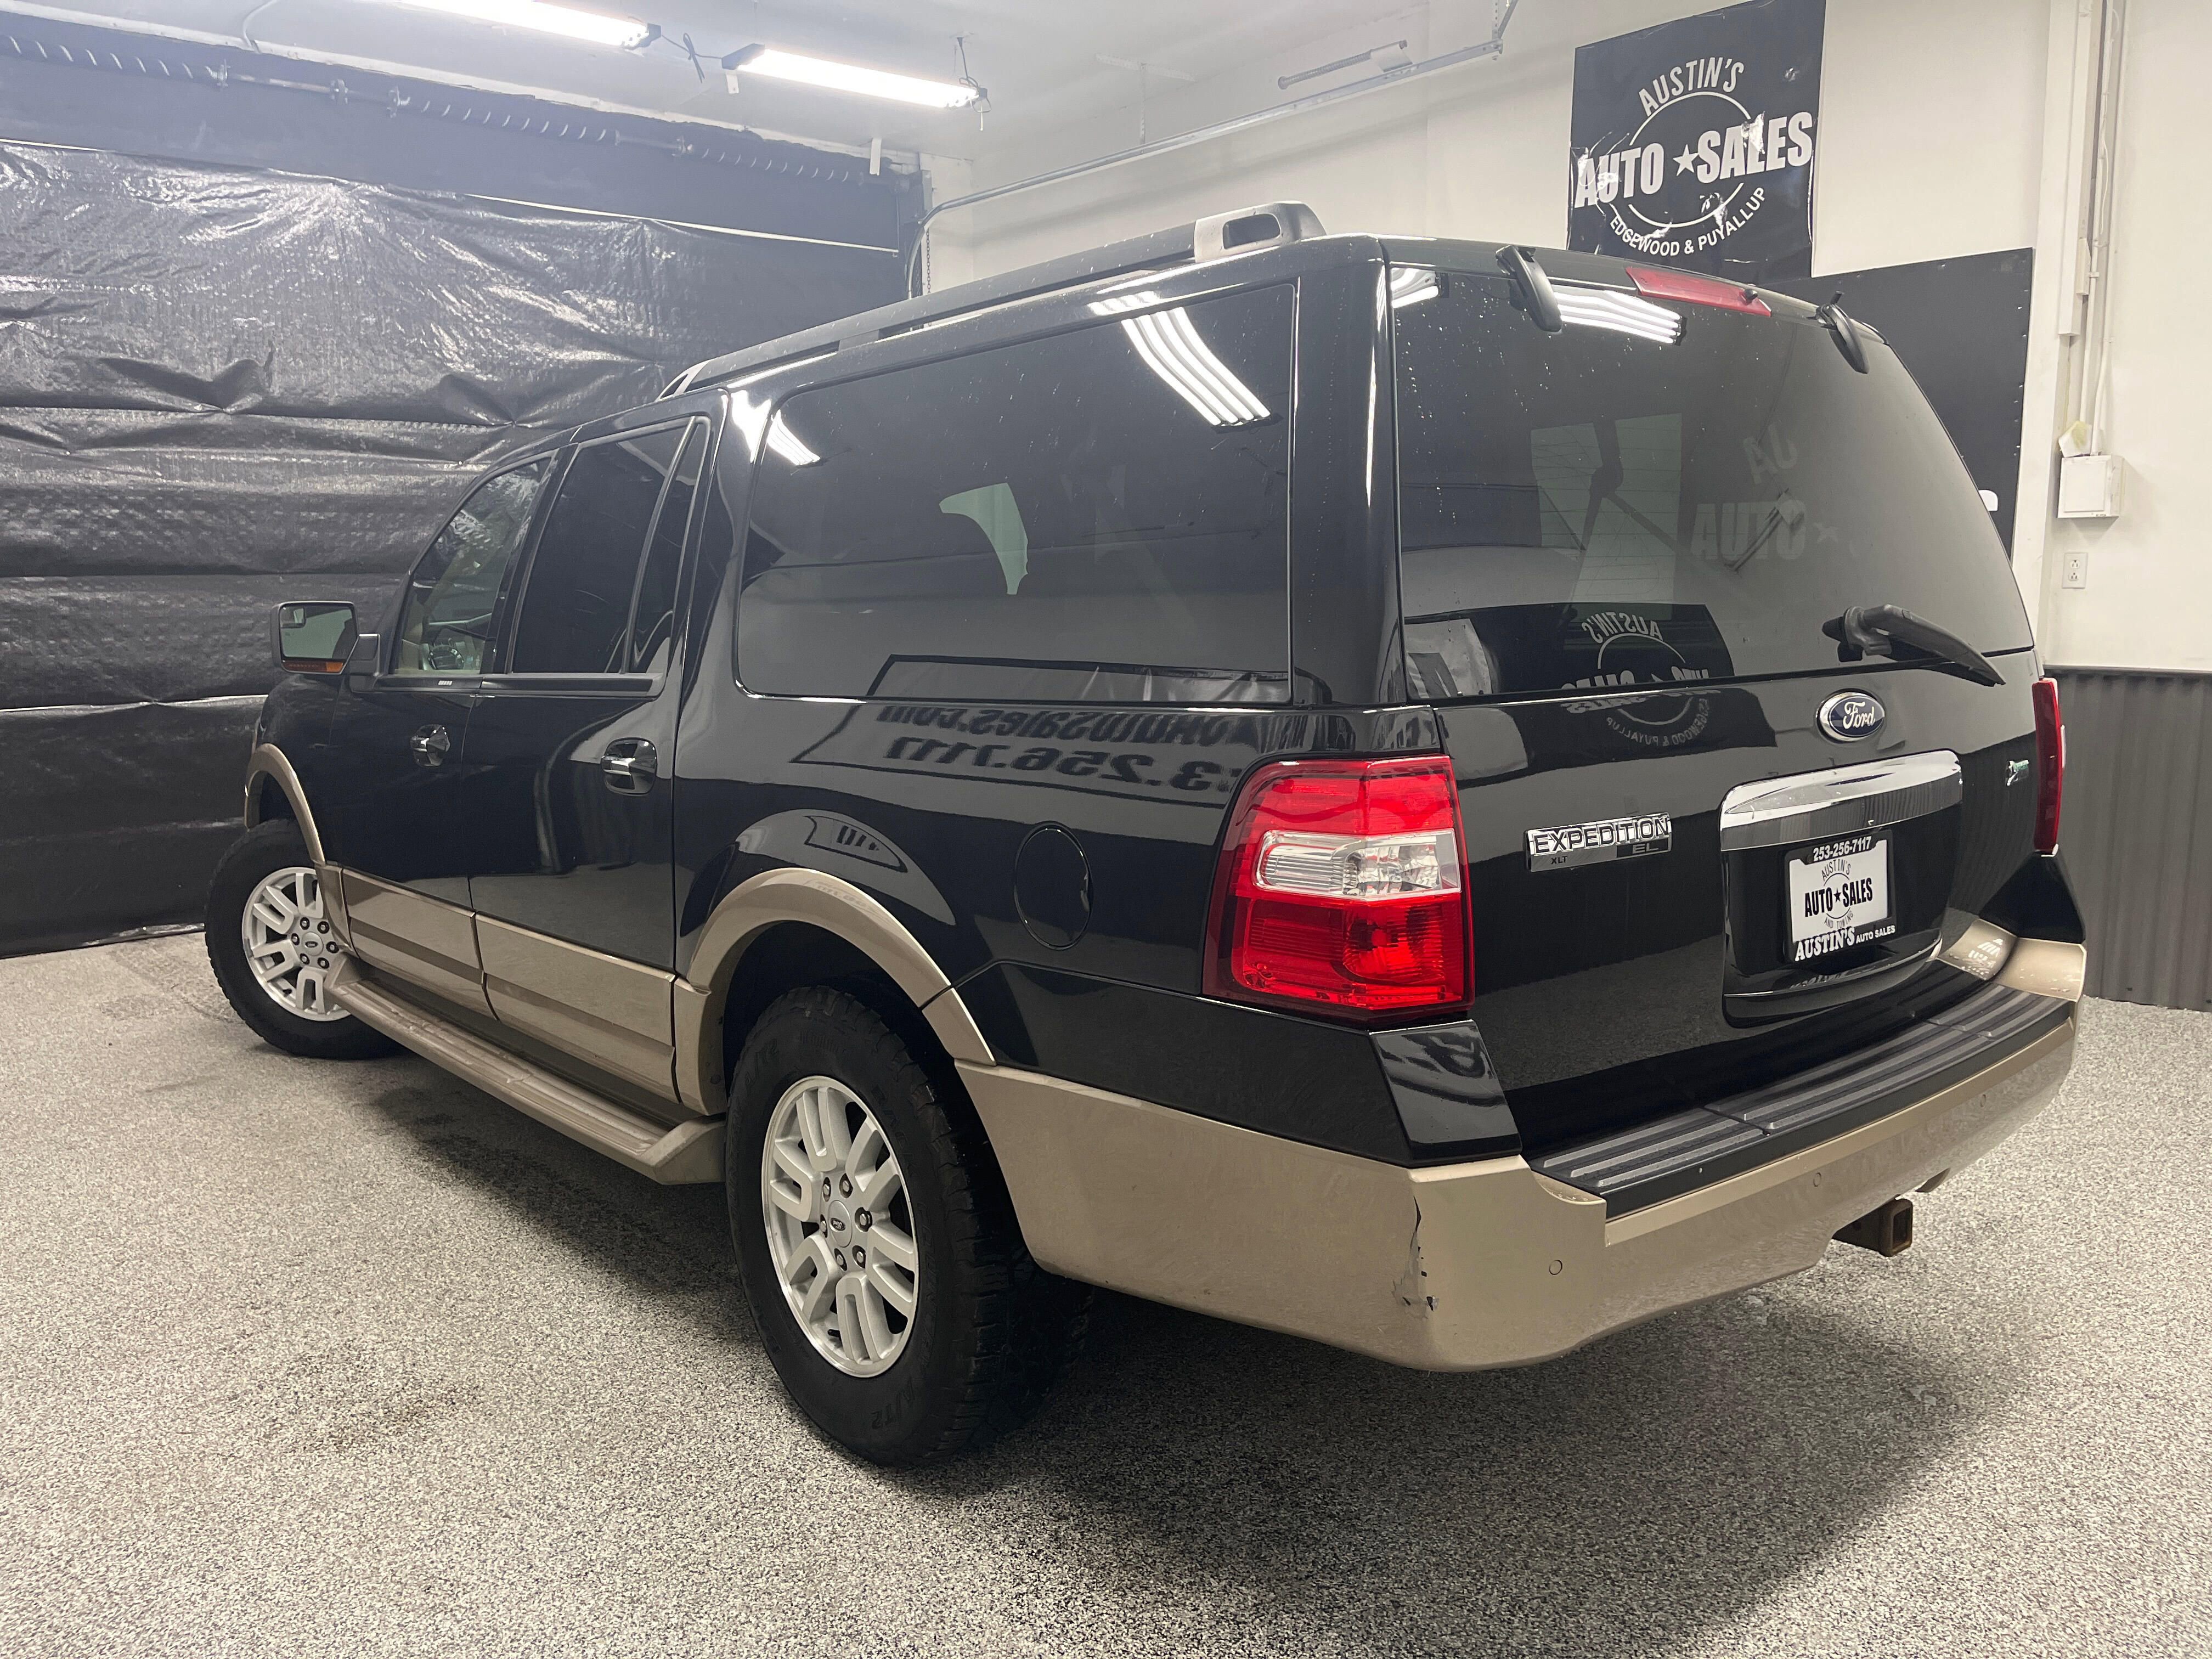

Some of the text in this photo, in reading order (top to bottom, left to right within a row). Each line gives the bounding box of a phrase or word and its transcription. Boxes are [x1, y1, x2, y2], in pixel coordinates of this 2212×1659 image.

[1638, 57, 1745, 117] AUSTIN'S
[1574, 111, 1813, 208] AUTO SALES
[1610, 187, 1767, 257] EDGEWOOD & PUYALLUP
[1843, 701, 1876, 729] Ford
[1533, 816, 1669, 856] EXPEDITION
[1550, 843, 1659, 865] XLT EL
[1813, 836, 1872, 862] 253-256-7117
[1821, 859, 1852, 881] AUSTIN'S
[1804, 877, 1873, 917] AUTO SALES
[1824, 917, 1834, 929] AND
[1795, 925, 1895, 962] AUSTIN'S AUTO SALES
